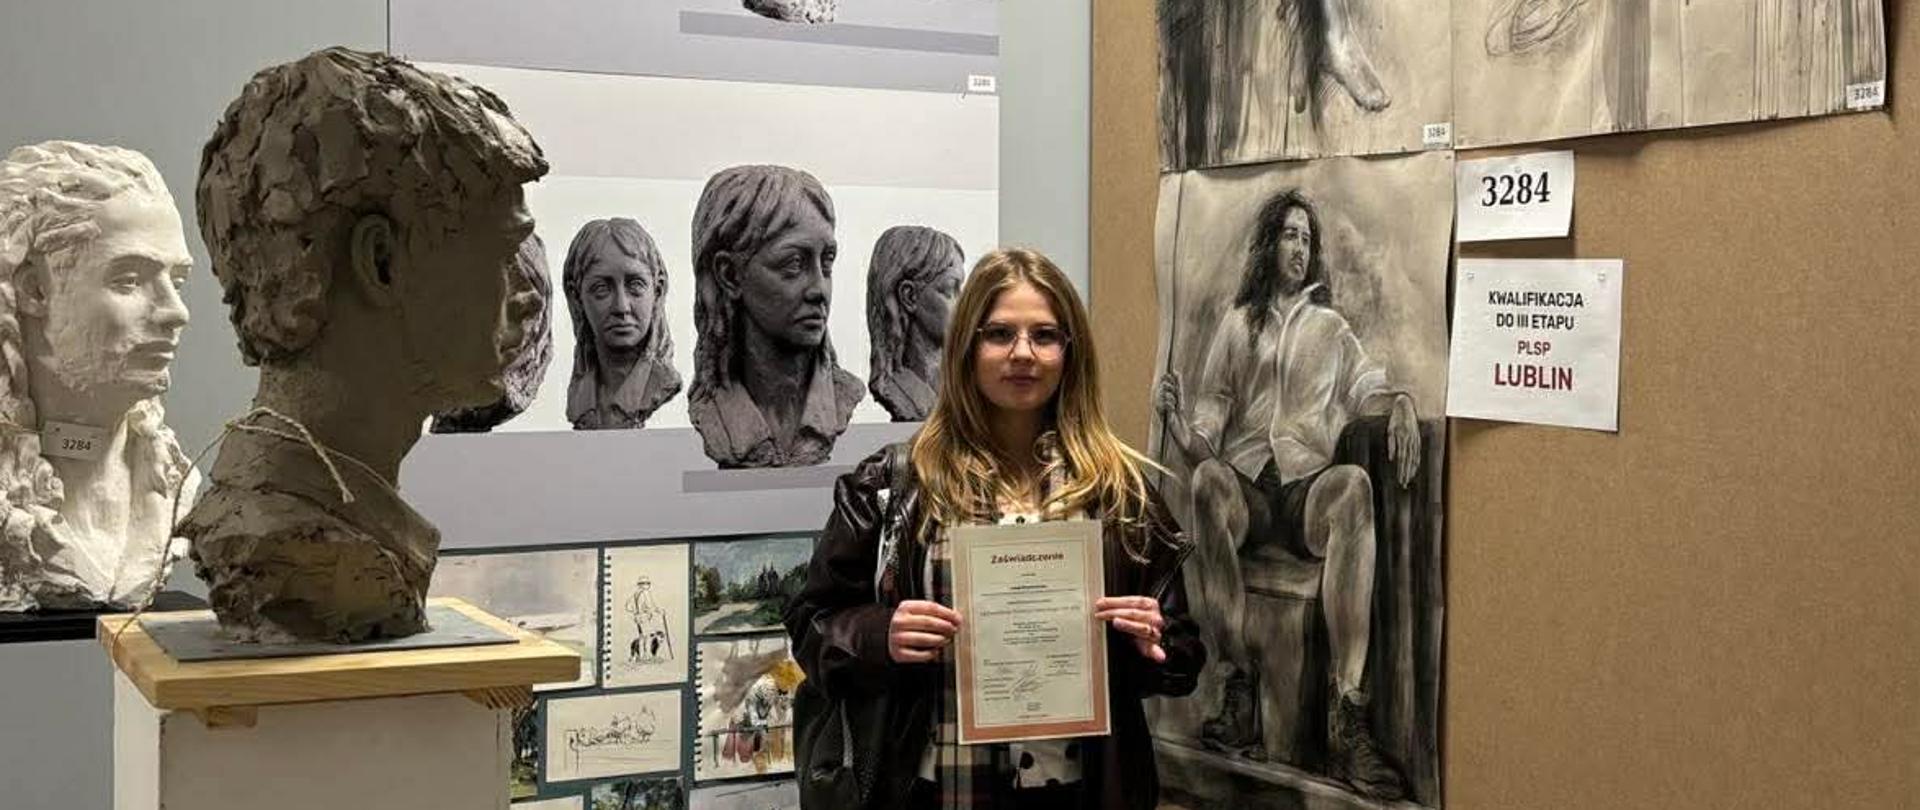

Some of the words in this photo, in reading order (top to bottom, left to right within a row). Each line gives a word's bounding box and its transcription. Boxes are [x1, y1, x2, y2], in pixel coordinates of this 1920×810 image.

[1481, 171, 1551, 207] 3284
[1488, 290, 1584, 307] KWALIFIKACJA
[1496, 313, 1514, 327] DO
[1517, 314, 1529, 328] III
[1531, 314, 1575, 330] ETAPU
[1517, 340, 1551, 356] PLSP
[1494, 362, 1573, 391] LUBLIN
[62, 438, 91, 451] 3284
